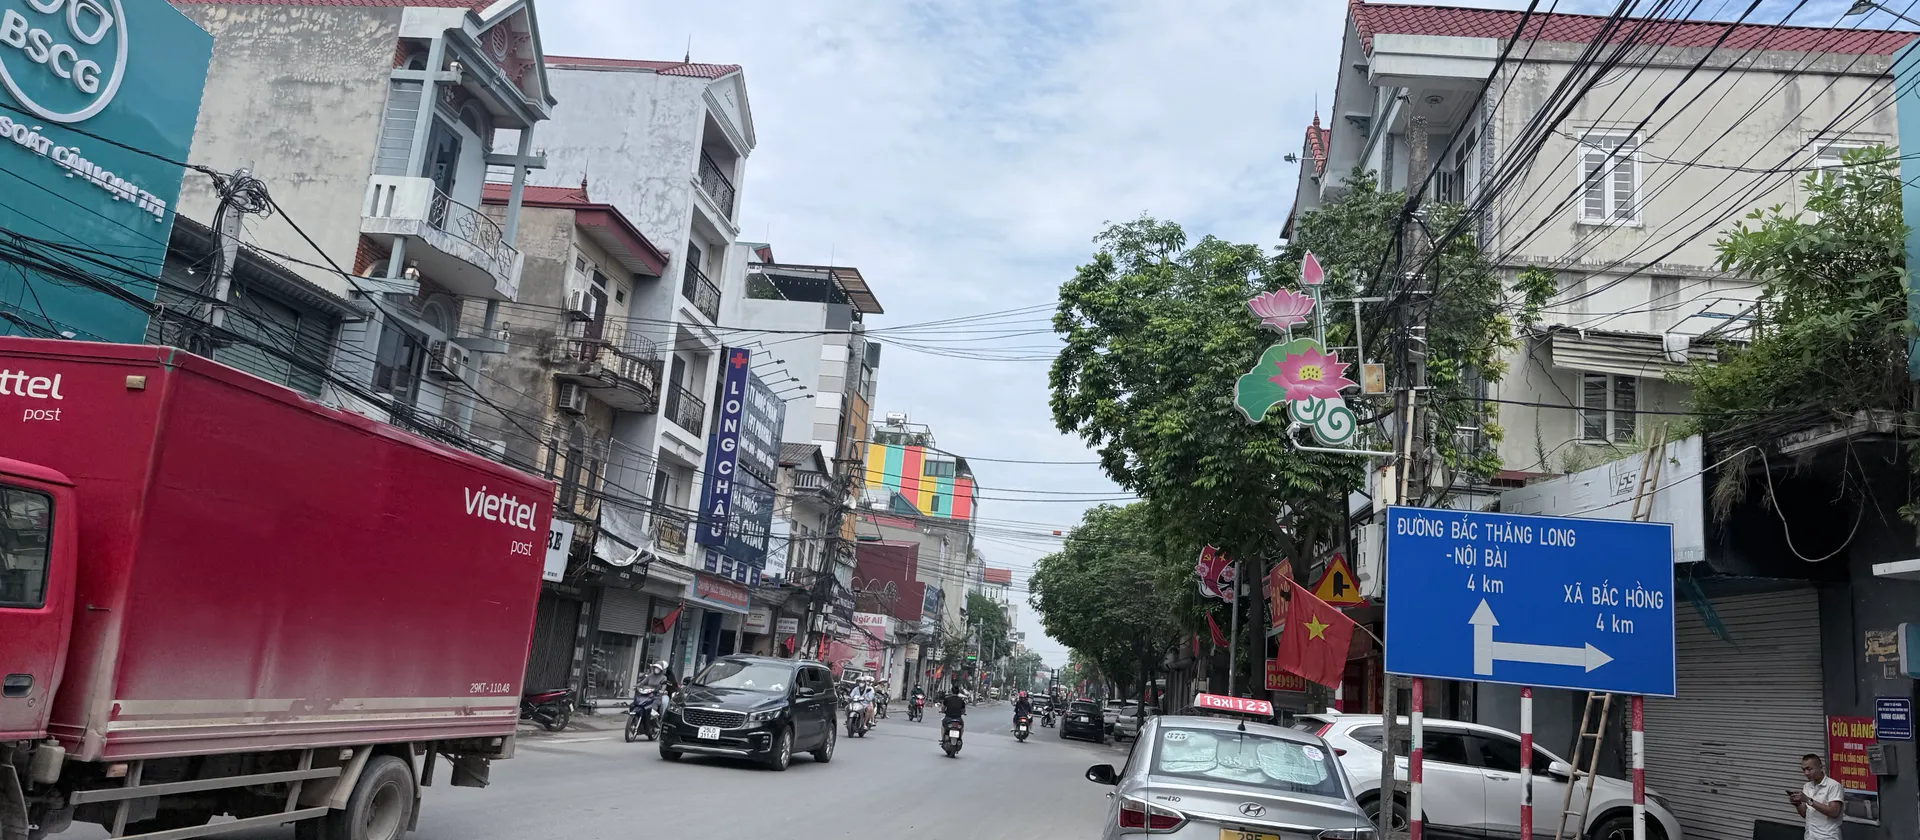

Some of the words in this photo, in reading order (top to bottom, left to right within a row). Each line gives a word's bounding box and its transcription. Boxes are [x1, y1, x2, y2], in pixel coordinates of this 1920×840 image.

[0, 9, 102, 94] BSCG
[0, 116, 54, 156] SOÁT
[0, 369, 64, 400] ttel
[23, 408, 62, 422] post
[721, 380, 740, 453] LONG
[465, 485, 538, 532] viettel
[711, 460, 733, 537] CHÂU
[1397, 513, 1444, 538] ĐƯỜNG
[1451, 514, 1478, 541] BẮC
[1486, 522, 1533, 545] THĂNG
[1540, 527, 1576, 548] LONG
[510, 540, 533, 556] post
[1485, 545, 1508, 569] BÀI
[1467, 573, 1476, 592] 4
[1483, 575, 1504, 594] km
[1563, 581, 1584, 605] XÃ
[1592, 579, 1619, 607] BẮC
[1625, 581, 1664, 610] HỒNG
[1596, 613, 1605, 632] 4
[1612, 614, 1634, 634] km
[1267, 673, 1304, 689] 9999
[1204, 695, 1234, 710] Taxi
[1831, 719, 1849, 738] CỬA
[1850, 720, 1875, 739] HÀNG
